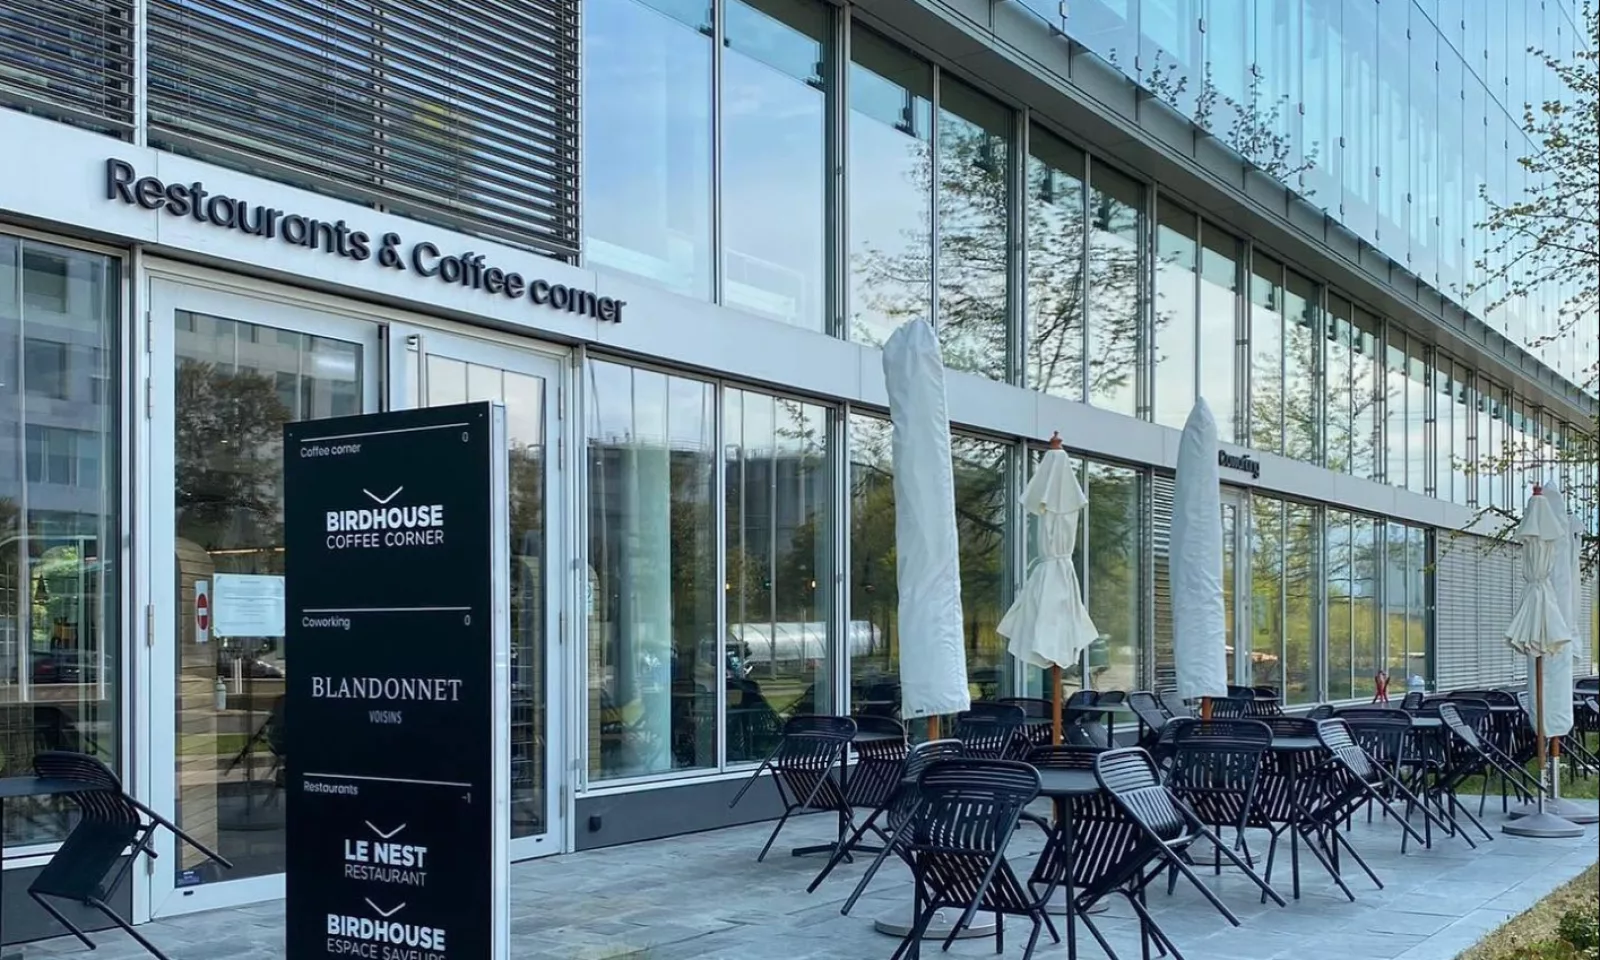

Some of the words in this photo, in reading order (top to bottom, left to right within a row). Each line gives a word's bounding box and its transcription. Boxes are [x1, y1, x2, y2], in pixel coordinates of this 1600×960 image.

[106, 158, 371, 260] Restaurants
[378, 232, 406, 270] &
[412, 242, 524, 299] Coffee
[530, 276, 627, 324] corner
[300, 445, 330, 458] Coffee
[331, 443, 361, 455] corner
[326, 504, 444, 532] BIRDHOUSE
[326, 533, 380, 549] COFFEE
[384, 530, 444, 547] CORNER
[302, 617, 351, 630] Coworking
[311, 676, 463, 701] BLANDONNET
[368, 710, 402, 725] VOISINS
[303, 780, 358, 796] Restaurants
[344, 838, 368, 862] LE
[373, 842, 427, 868] NEST
[344, 863, 427, 887] RESTAURANT
[327, 913, 445, 952] BIRDHOUSE
[327, 938, 378, 960] ESPACE
